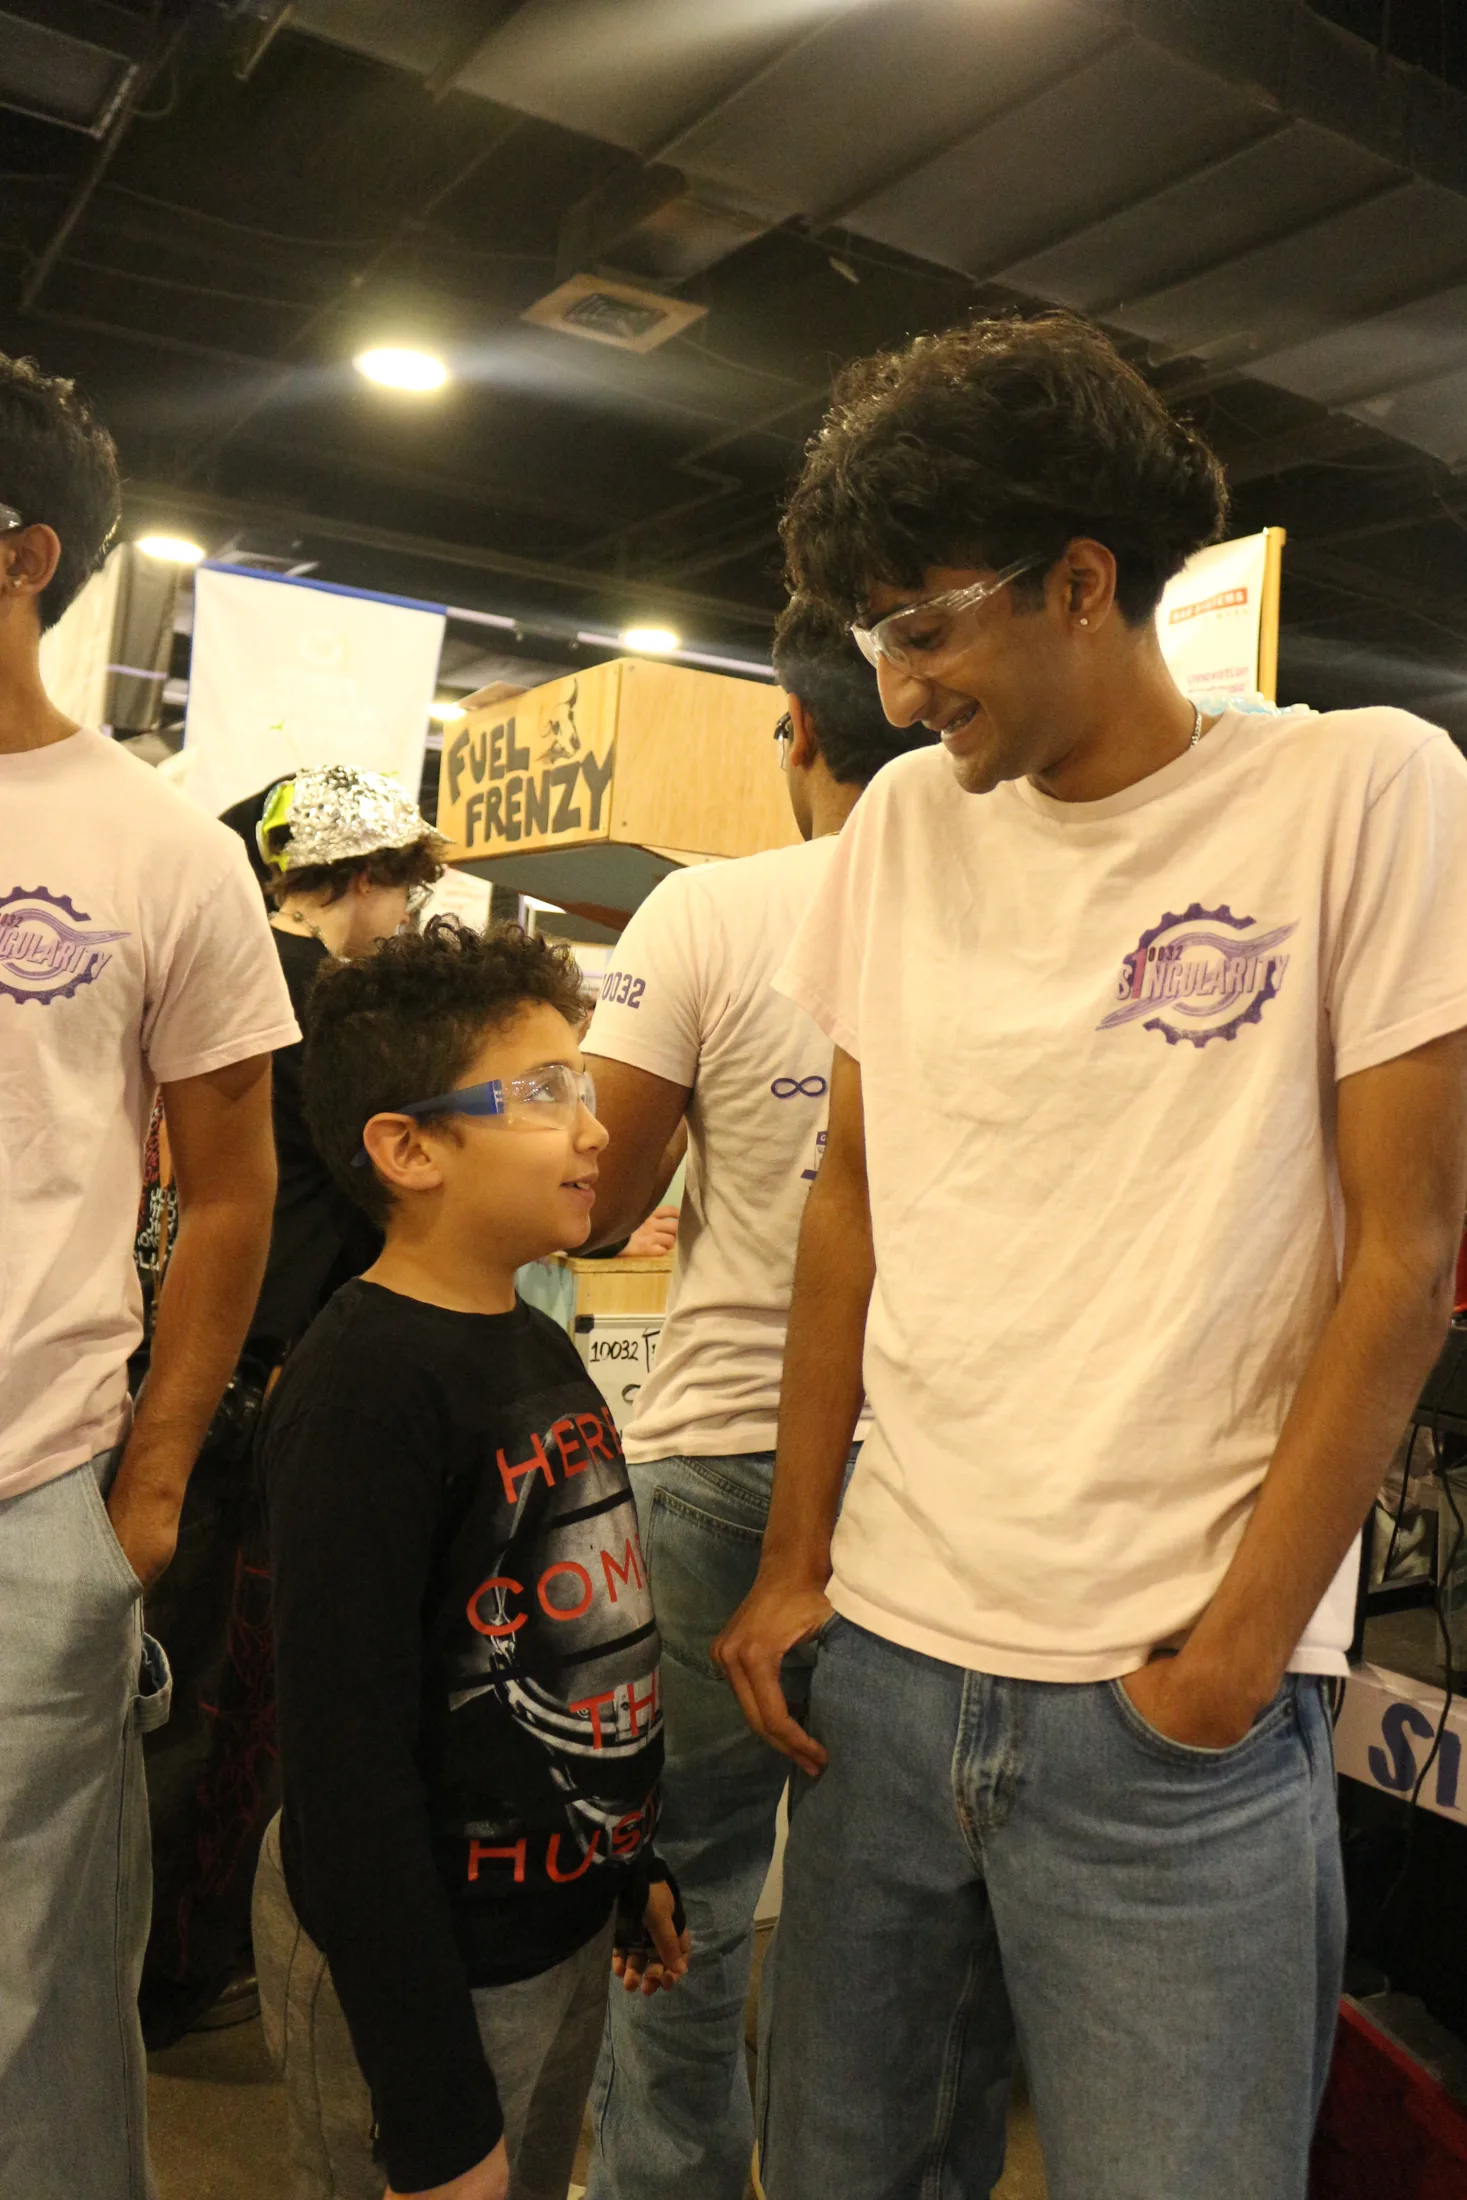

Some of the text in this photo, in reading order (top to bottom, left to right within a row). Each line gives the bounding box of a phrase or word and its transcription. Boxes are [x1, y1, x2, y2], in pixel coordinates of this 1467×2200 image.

[448, 716, 530, 805] FUEL
[465, 738, 616, 848] FRENZY
[0, 912, 24, 928] 032
[601, 971, 646, 1009] 0032
[590, 1340, 639, 1362] 10032
[466, 1533, 648, 1636] COM
[467, 1800, 655, 1883] HUS
